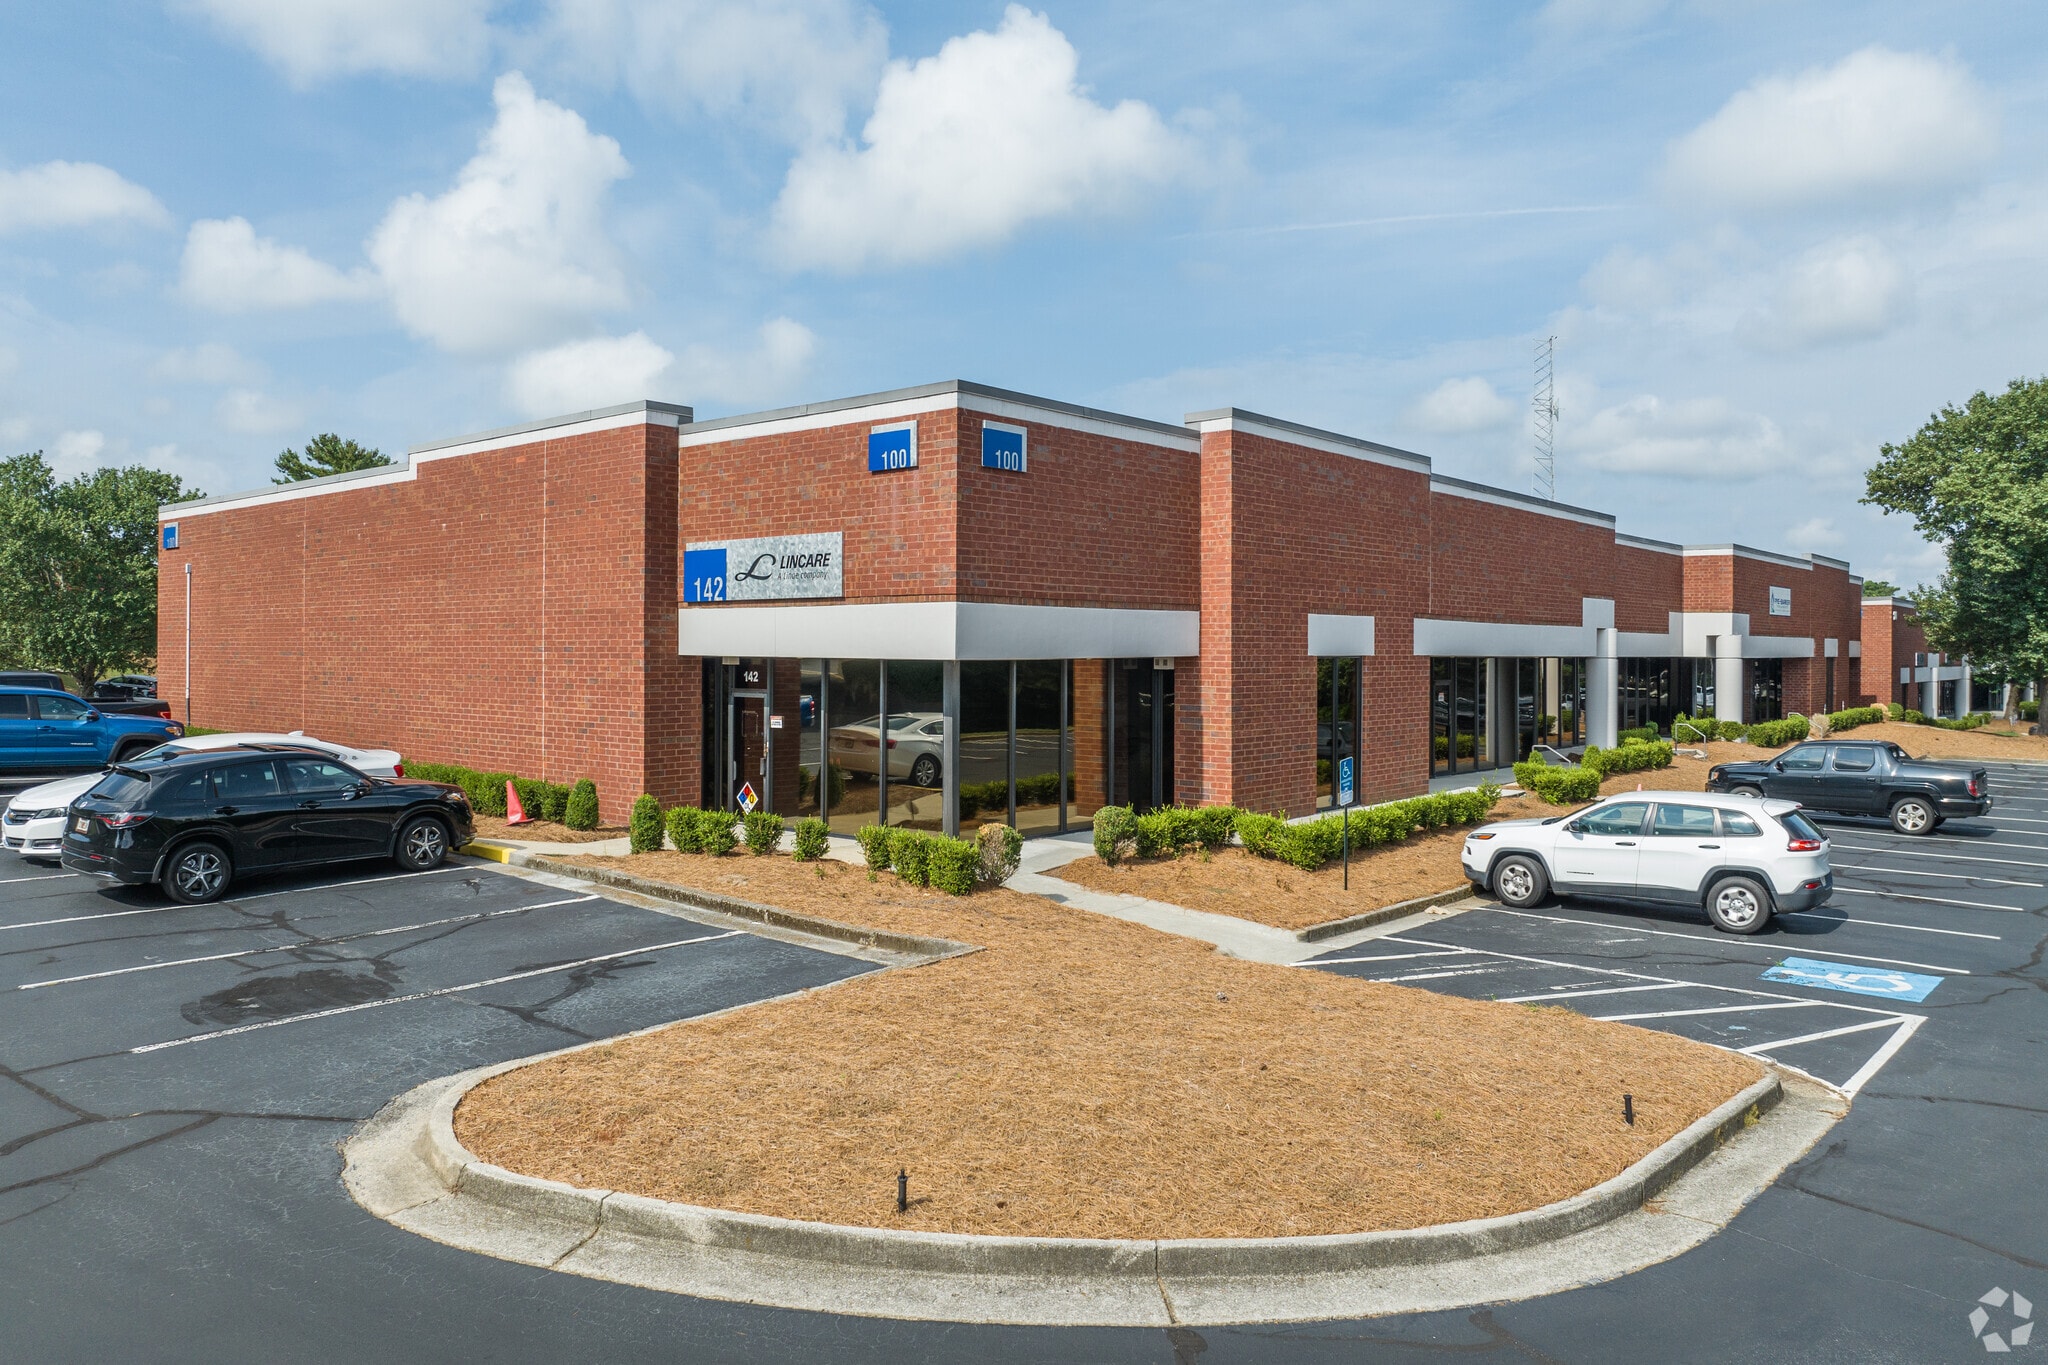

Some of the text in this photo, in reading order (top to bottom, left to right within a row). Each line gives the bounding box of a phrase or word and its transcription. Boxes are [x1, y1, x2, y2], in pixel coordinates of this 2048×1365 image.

[881, 449, 907, 470] 100
[995, 450, 1019, 471] 100
[780, 553, 831, 569] LINCARE
[800, 571, 829, 581] company
[694, 577, 723, 601] 142
[744, 671, 758, 682] 142
